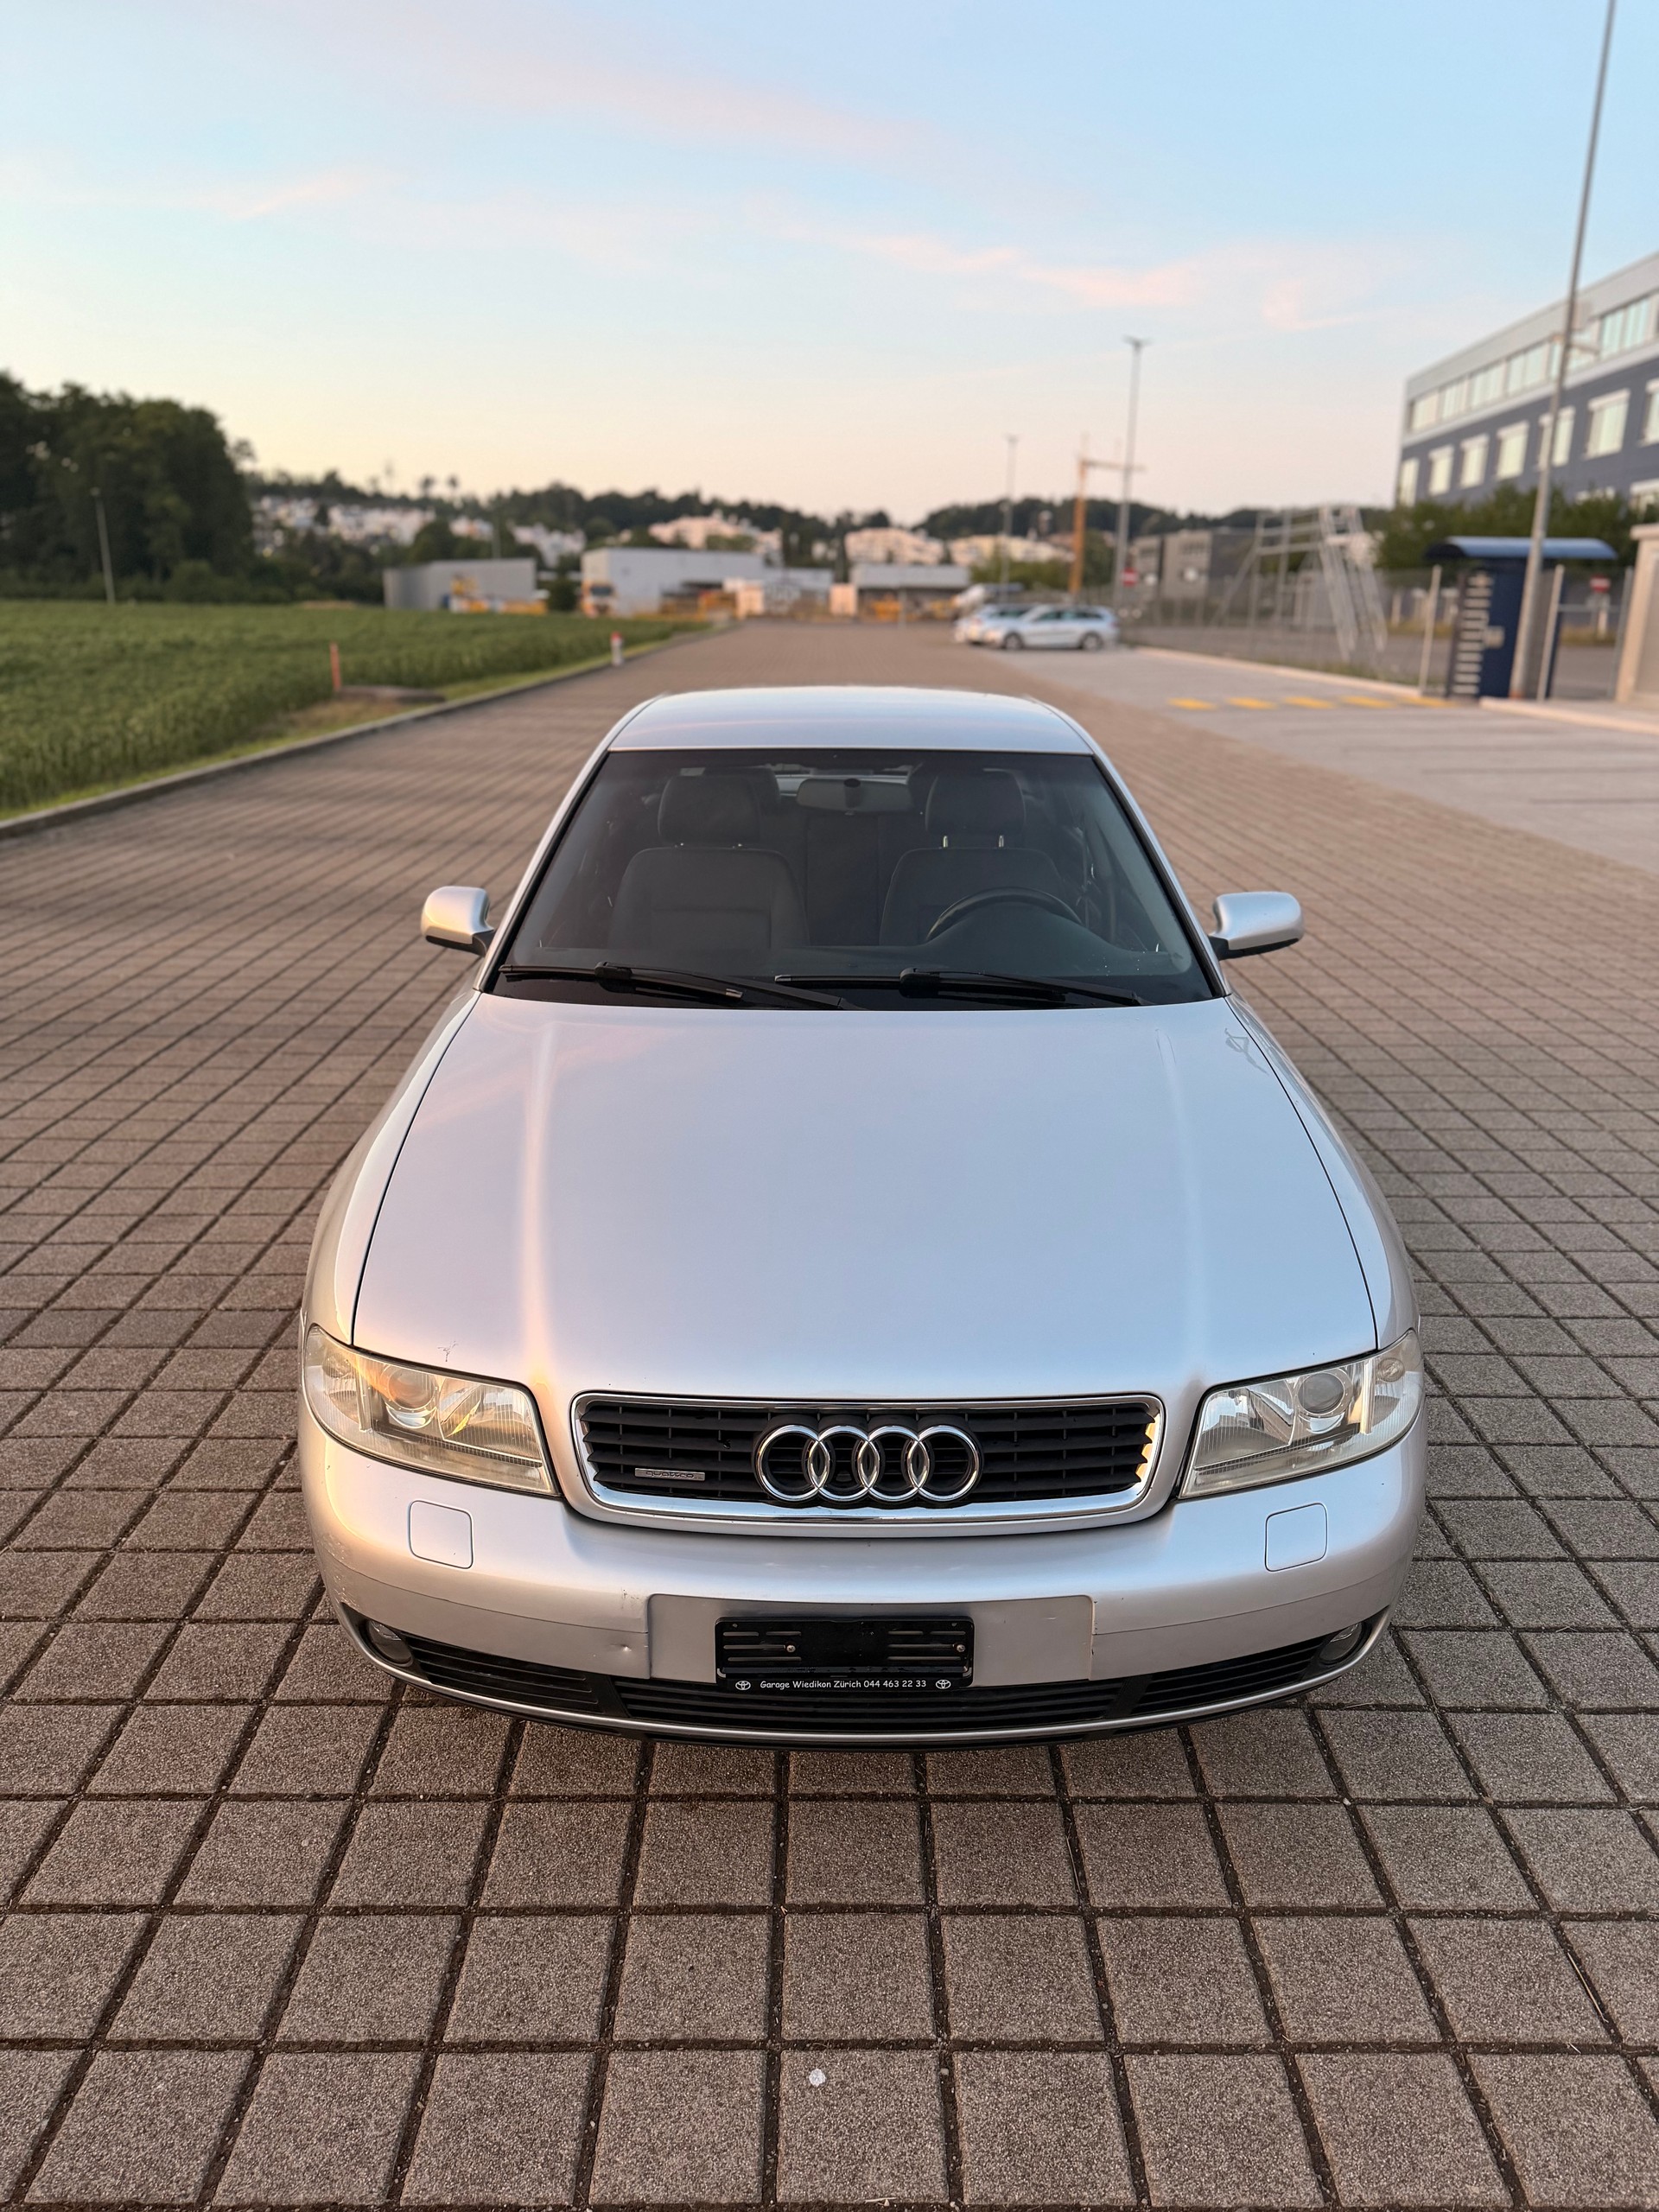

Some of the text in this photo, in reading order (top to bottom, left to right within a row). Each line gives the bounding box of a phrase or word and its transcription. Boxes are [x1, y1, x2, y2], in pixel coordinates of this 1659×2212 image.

[760, 1680, 790, 1690] Garage
[792, 1680, 831, 1688] Wiedikon
[833, 1680, 861, 1688] Zürich
